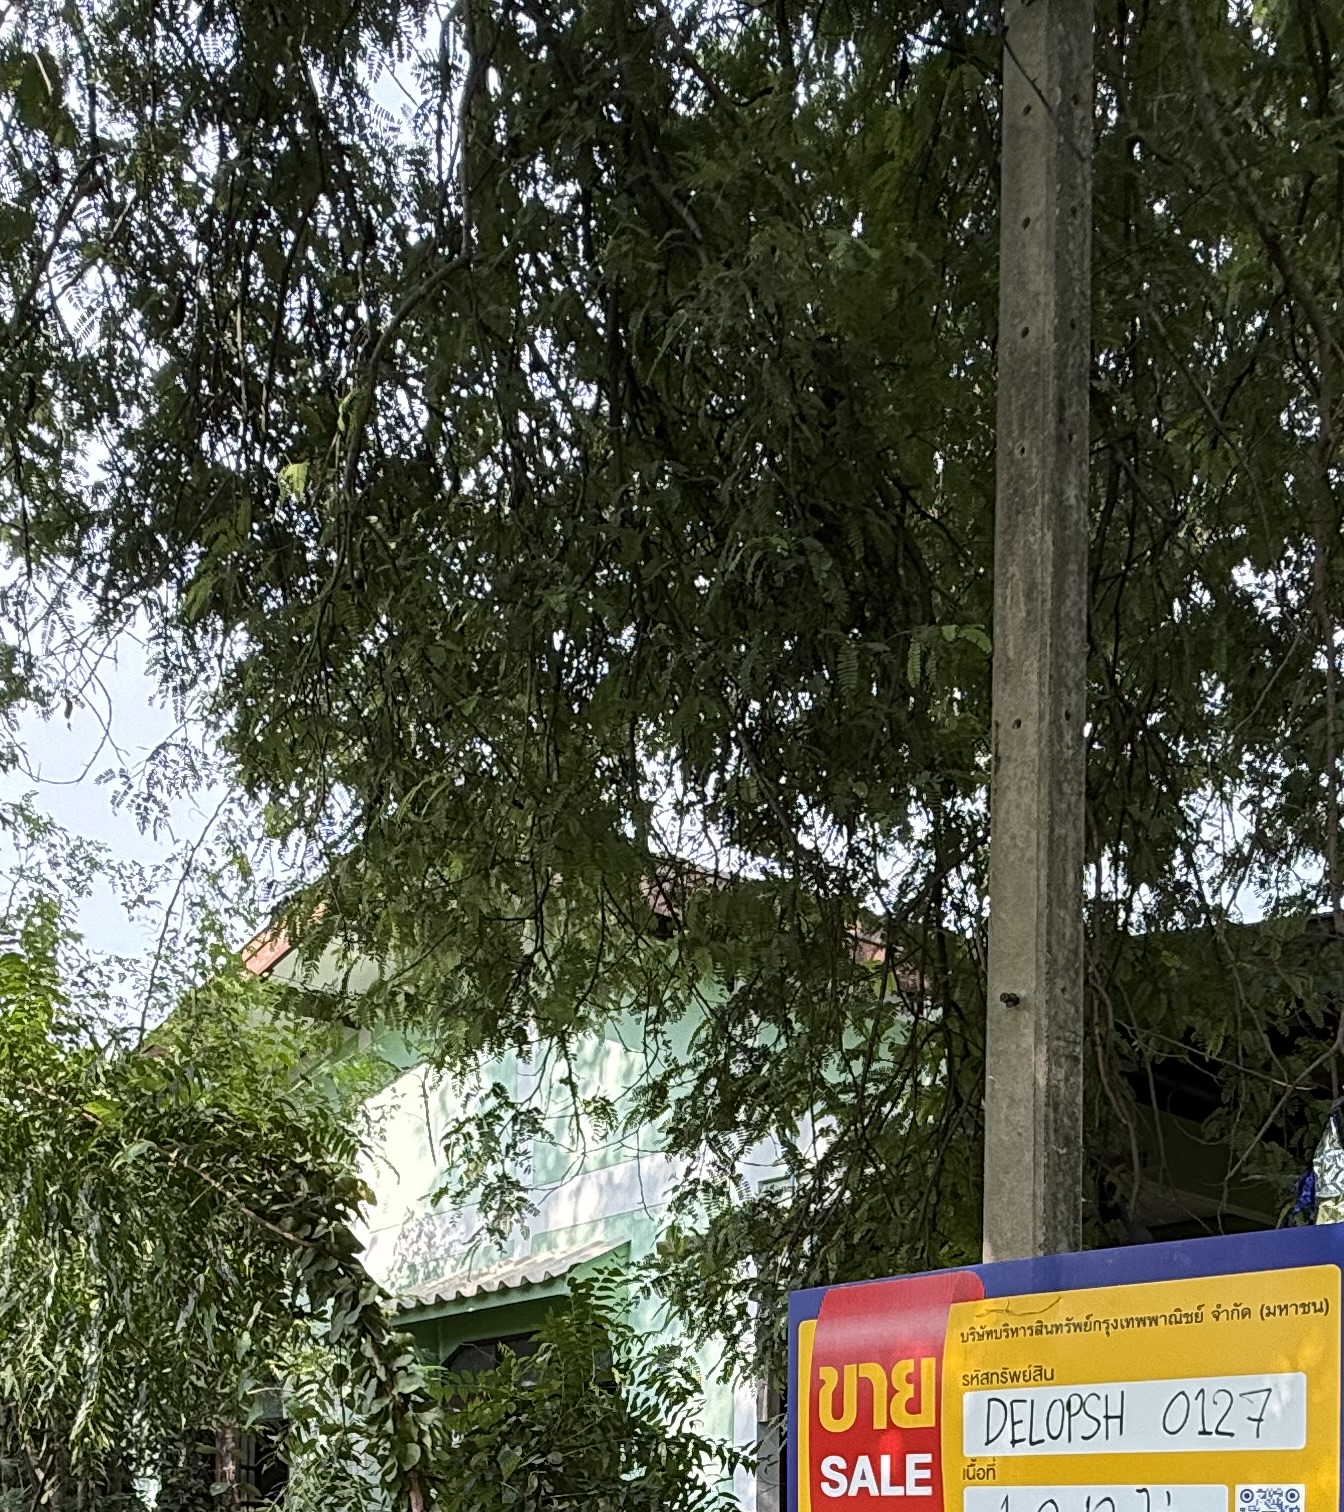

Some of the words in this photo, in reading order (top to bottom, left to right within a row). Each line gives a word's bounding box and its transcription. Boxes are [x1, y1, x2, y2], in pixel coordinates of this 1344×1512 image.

[959, 1305, 1204, 1344] บริษัทบริหารสินทรัพย์กรุงเทพพาณิชย์
[1211, 1303, 1252, 1322] จำกัด
[1259, 1298, 1331, 1321] (มหาชน)
[818, 1357, 937, 1433] ขาย
[961, 1365, 1055, 1387] รหัสทรัพย์สิน
[1162, 1387, 1273, 1438] 0127
[820, 1453, 933, 1498] SALE
